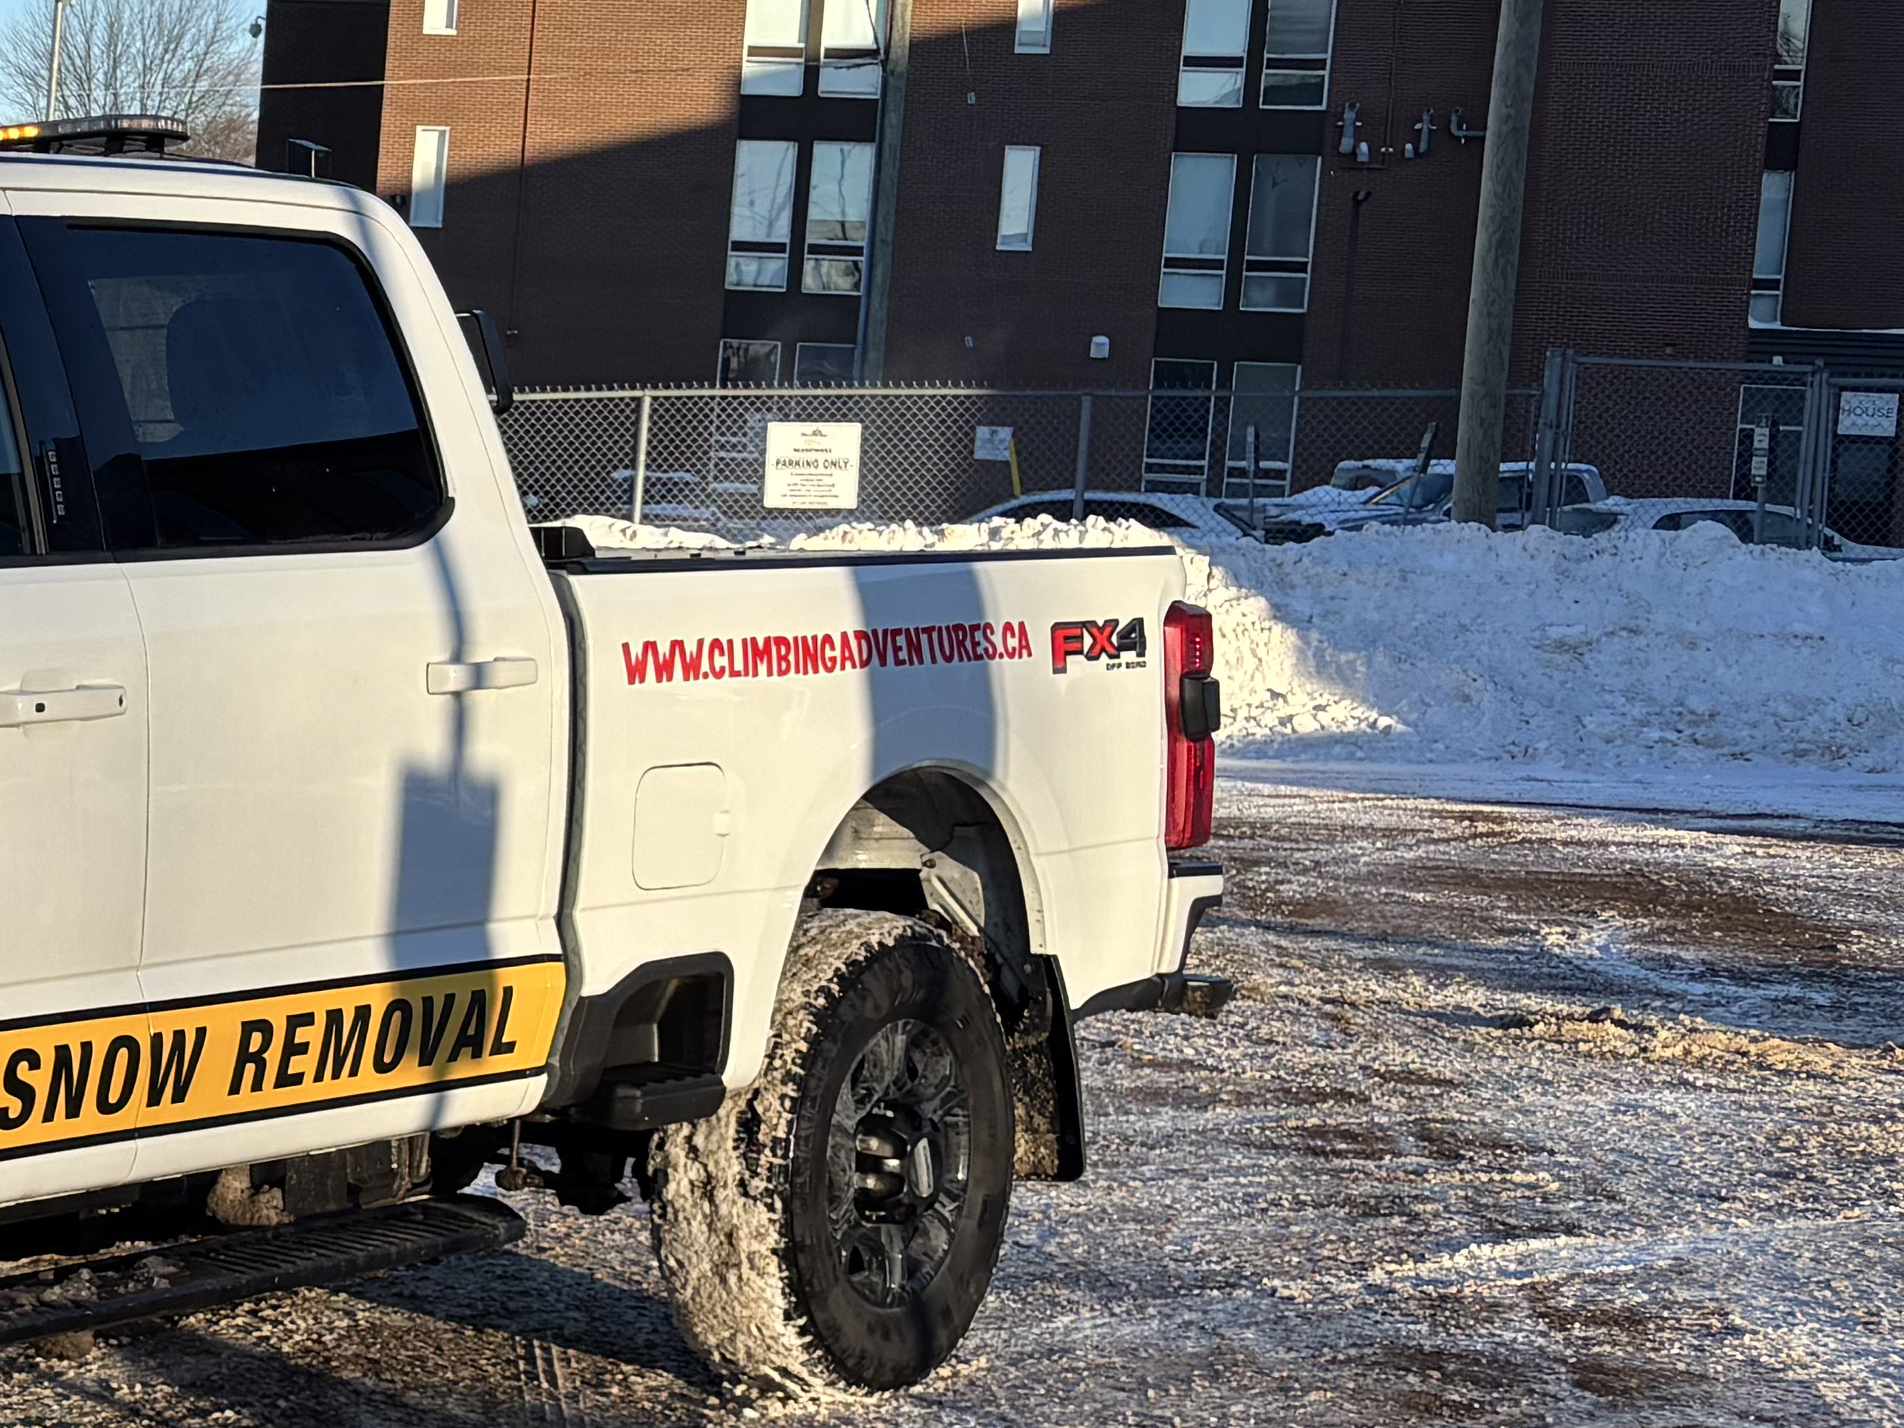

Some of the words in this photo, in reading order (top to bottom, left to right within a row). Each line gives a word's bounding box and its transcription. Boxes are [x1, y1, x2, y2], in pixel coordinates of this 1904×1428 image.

[1842, 406, 1894, 419] HOUSE
[776, 458, 819, 470] PARKING
[823, 458, 850, 470] ONLY
[621, 620, 1033, 686] WWW.CLIMBINGADVENTURES.CA
[1050, 617, 1147, 675] FX4
[227, 985, 517, 1097] REMOVAL
